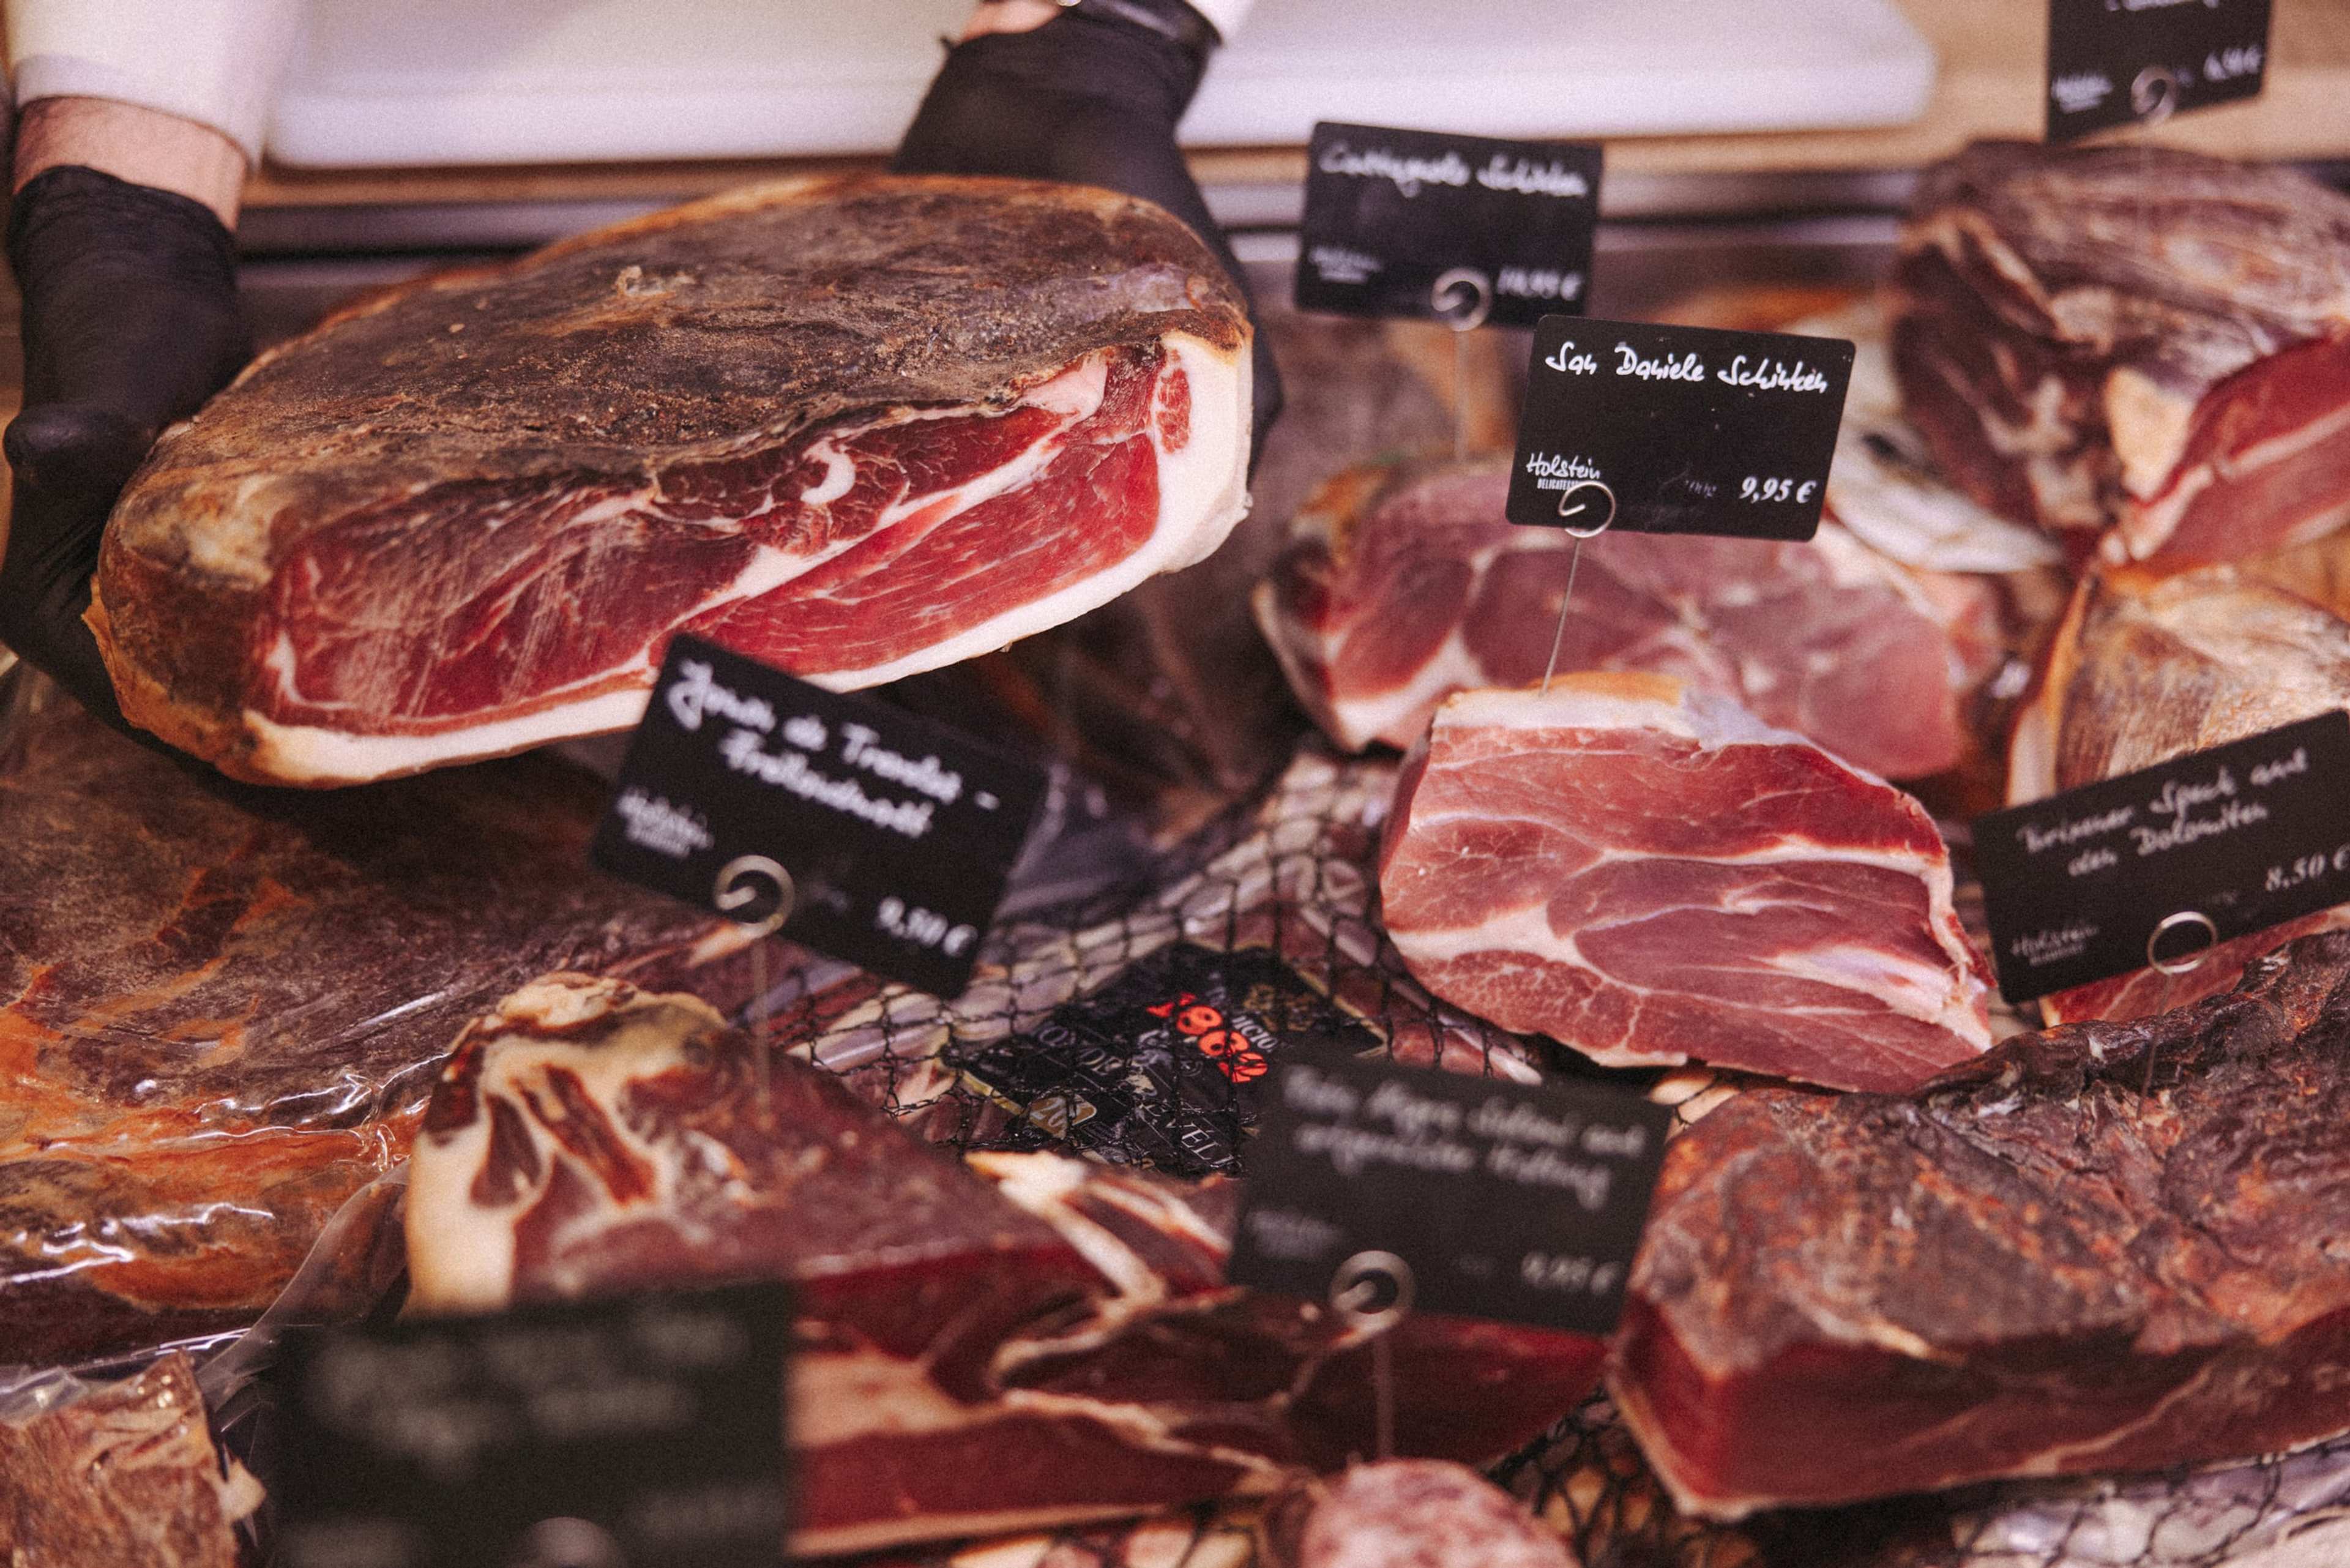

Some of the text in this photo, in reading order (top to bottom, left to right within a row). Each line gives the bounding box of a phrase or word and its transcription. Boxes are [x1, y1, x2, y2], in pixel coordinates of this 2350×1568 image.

[1545, 342, 1827, 394] San Daniele Schinken
[1526, 452, 1601, 479] Holstein
[1738, 477, 1794, 504] 9,95
[1796, 480, 1818, 504] €
